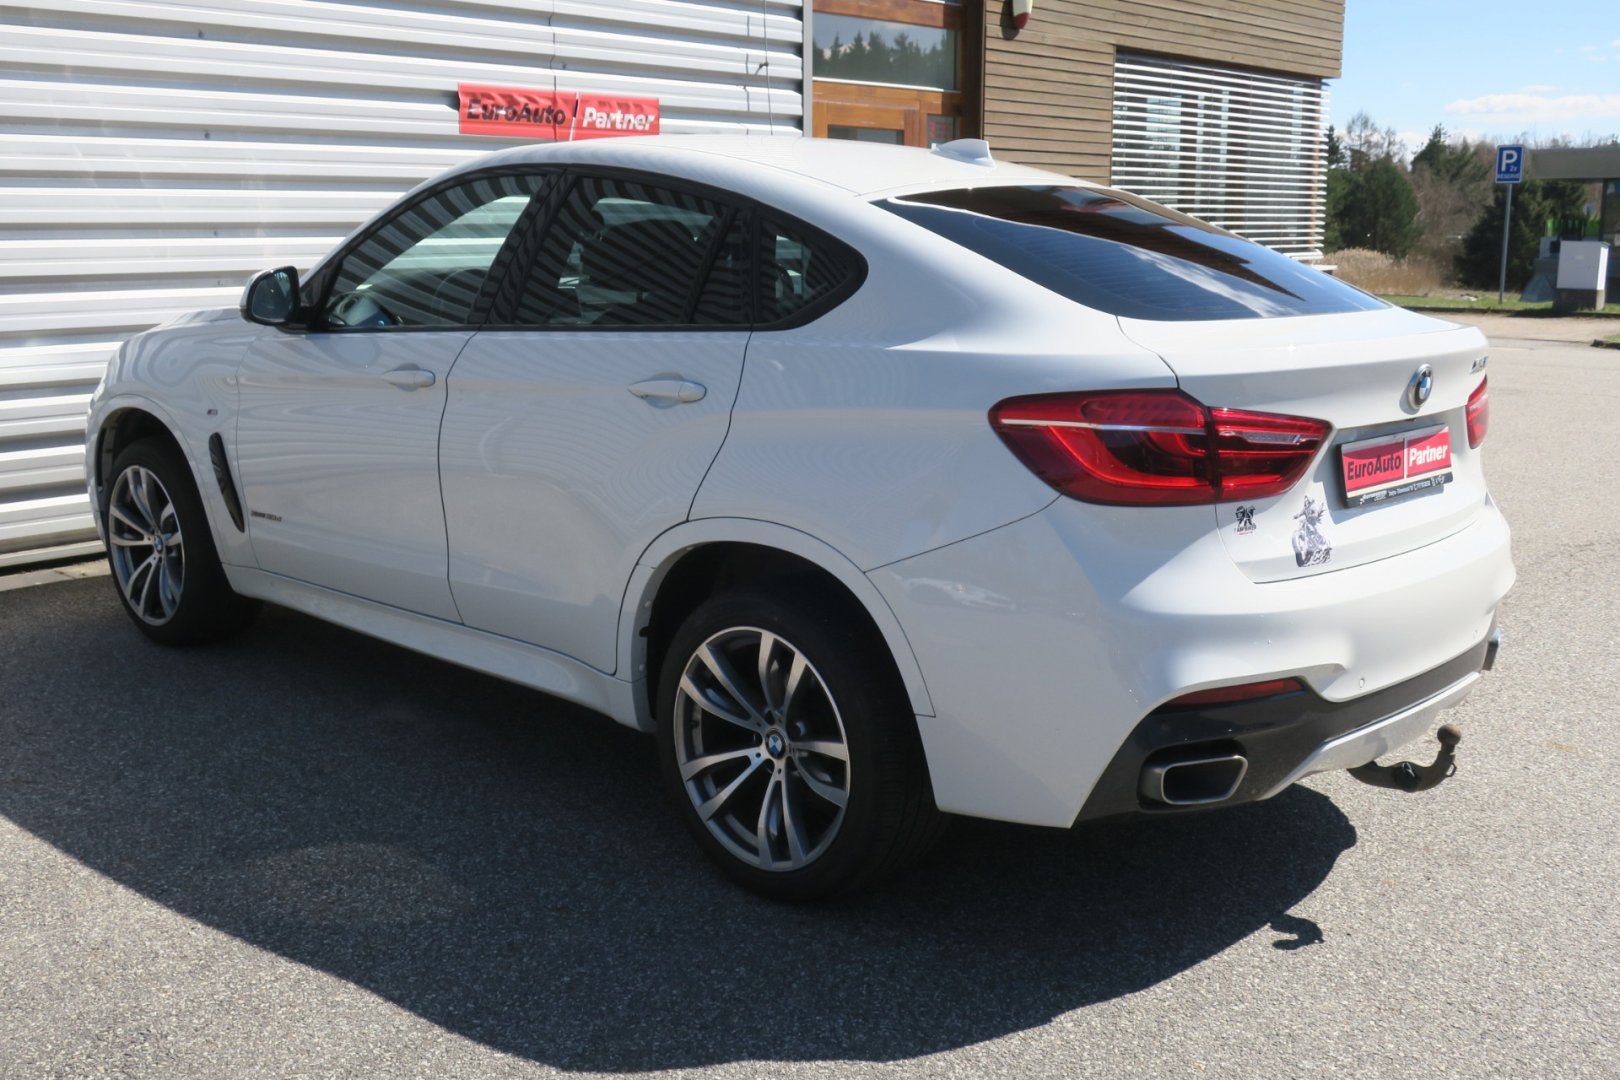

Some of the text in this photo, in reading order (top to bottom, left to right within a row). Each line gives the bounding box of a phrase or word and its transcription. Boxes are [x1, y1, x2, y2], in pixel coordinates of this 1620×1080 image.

[467, 98, 655, 131] EuroAuto Partner
[1501, 150, 1518, 171] P
[1347, 445, 1449, 481] EuroAuto Partner
